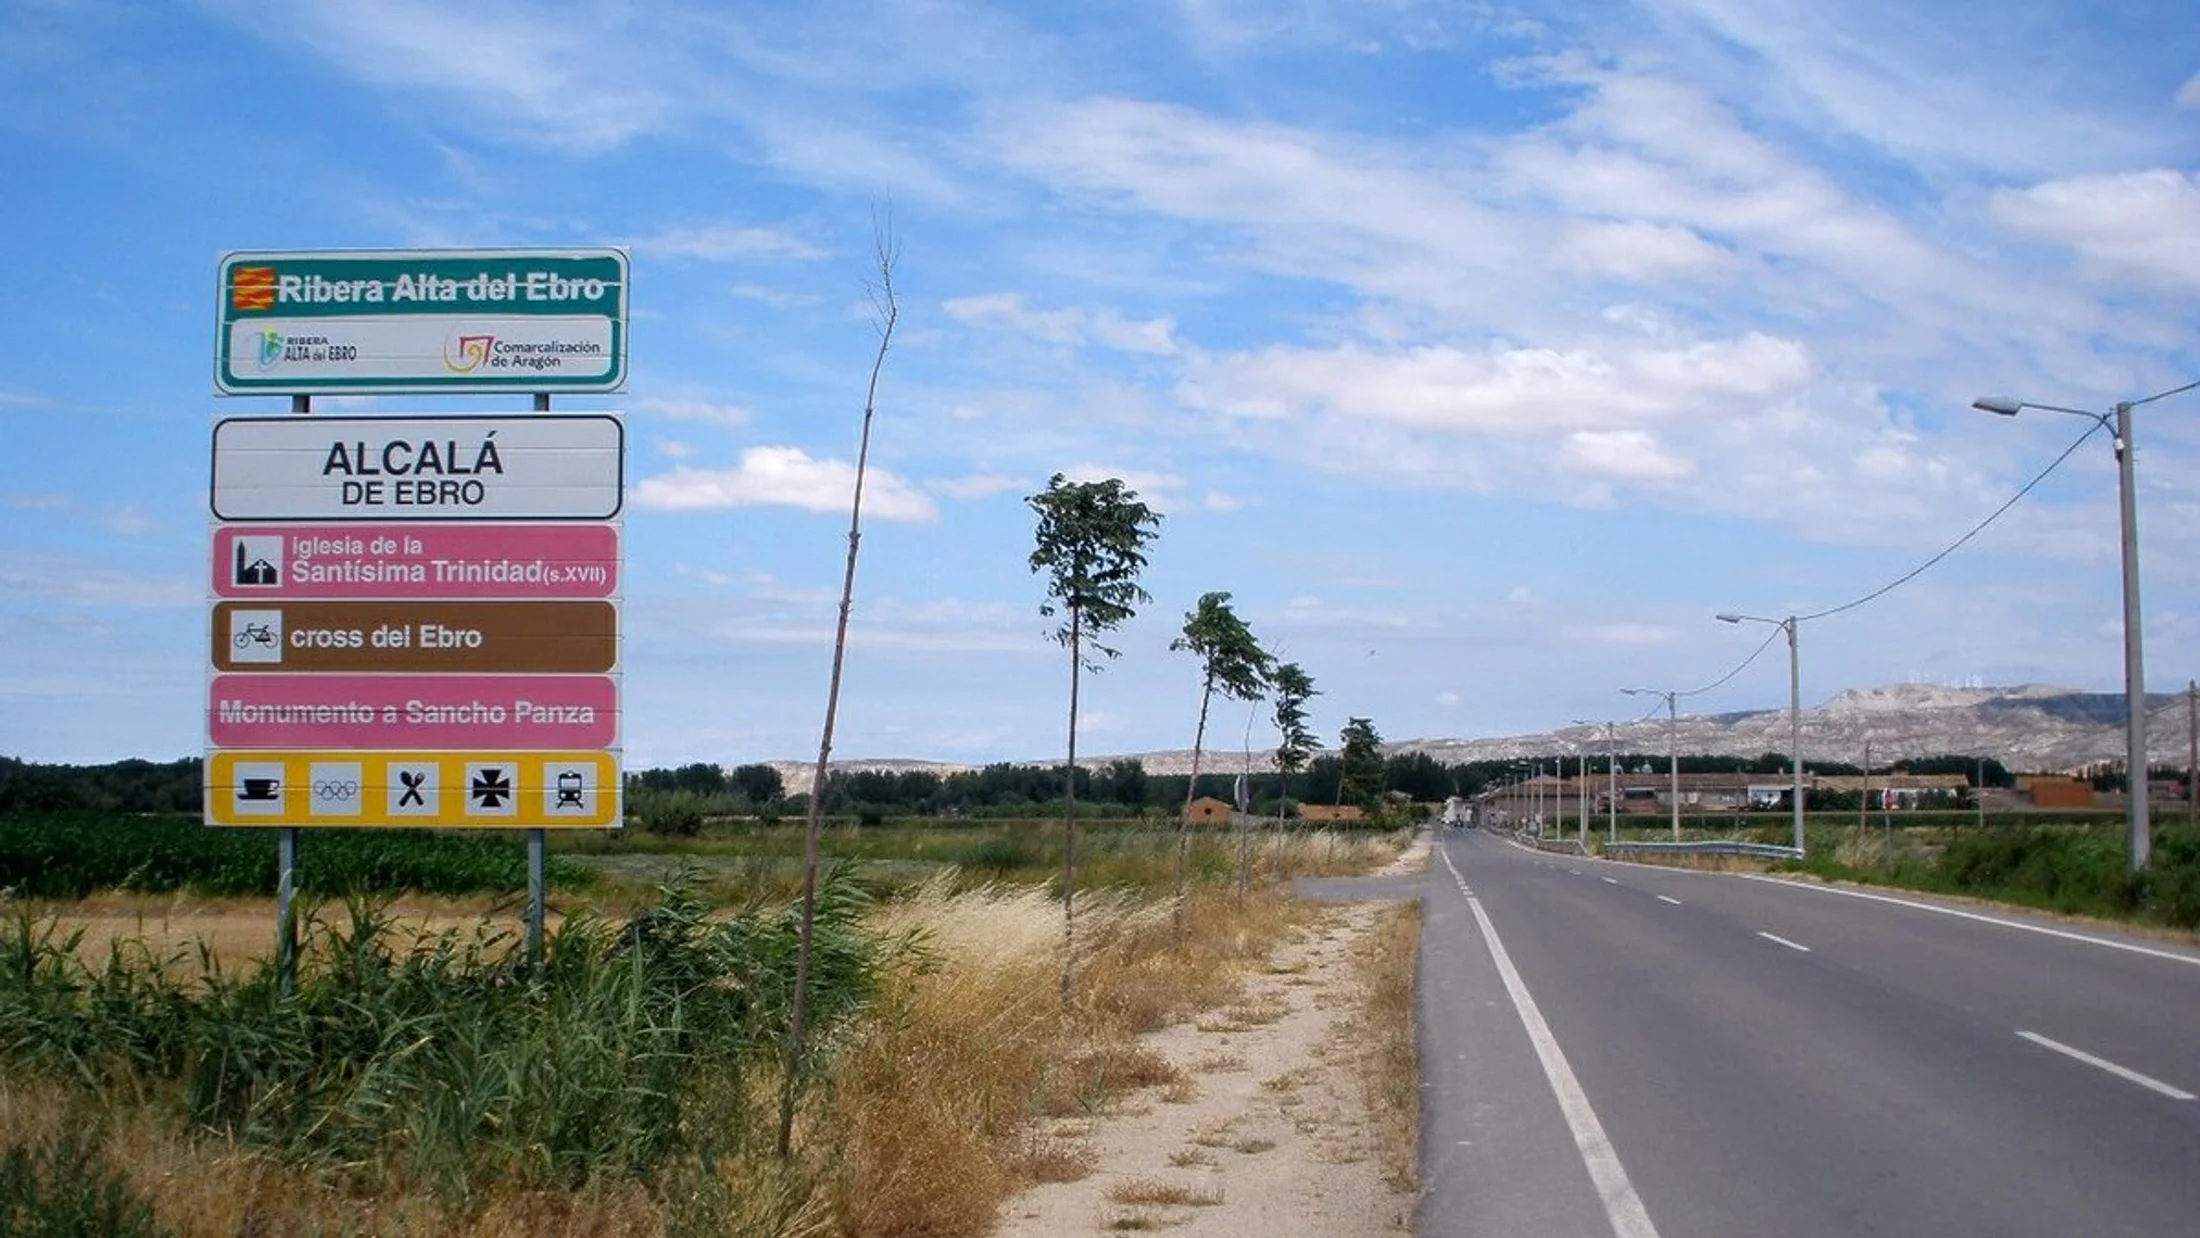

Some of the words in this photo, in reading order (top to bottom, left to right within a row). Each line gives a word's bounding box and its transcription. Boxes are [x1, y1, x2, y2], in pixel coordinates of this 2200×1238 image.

[278, 274, 384, 304] Ribera
[392, 272, 457, 302] Alta
[467, 271, 516, 301] del
[526, 272, 605, 301] Ebro
[286, 336, 329, 345] RIBERA
[493, 340, 601, 354] Comarcalización
[284, 346, 310, 361] ALTA
[312, 349, 326, 360] del
[328, 345, 357, 360] EBRO
[491, 356, 509, 367] de
[512, 355, 561, 370] Aragón
[323, 430, 504, 476] ALCALÁ
[342, 481, 384, 505] DE
[395, 479, 485, 505] EBRO
[292, 536, 364, 559] iglesia
[370, 537, 396, 554] de
[403, 536, 423, 554] la
[292, 560, 425, 583] Santísima
[290, 628, 364, 648] cross
[371, 625, 411, 648] del
[419, 625, 483, 648] Ebro
[219, 700, 375, 723] Monumento
[382, 706, 398, 723] a
[405, 701, 506, 723] Sancho
[514, 701, 594, 723] Panza
